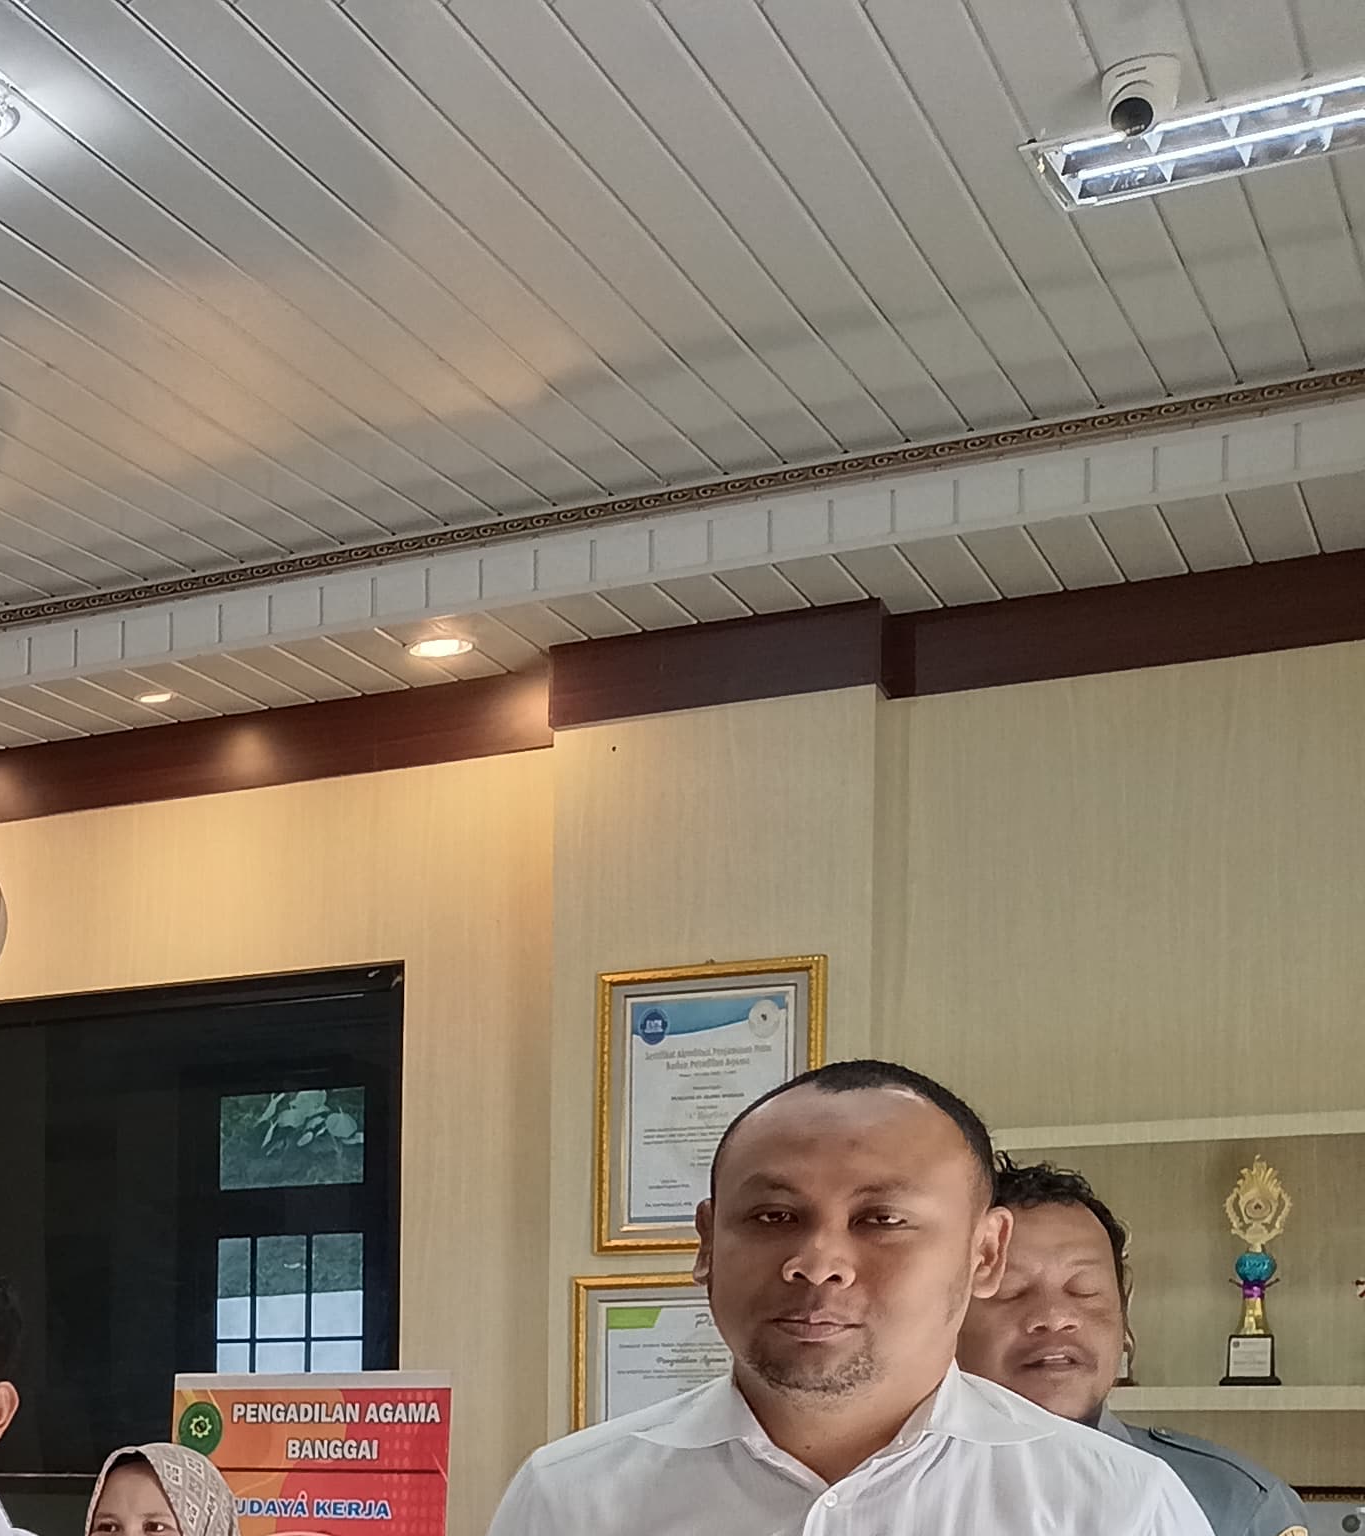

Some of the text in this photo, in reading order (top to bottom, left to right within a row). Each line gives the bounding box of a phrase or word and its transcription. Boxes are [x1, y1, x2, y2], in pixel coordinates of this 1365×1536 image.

[232, 1402, 441, 1424] PENGADILAN AGAMA
[286, 1438, 379, 1461] BANGGAI
[315, 1500, 391, 1518] KERJA
